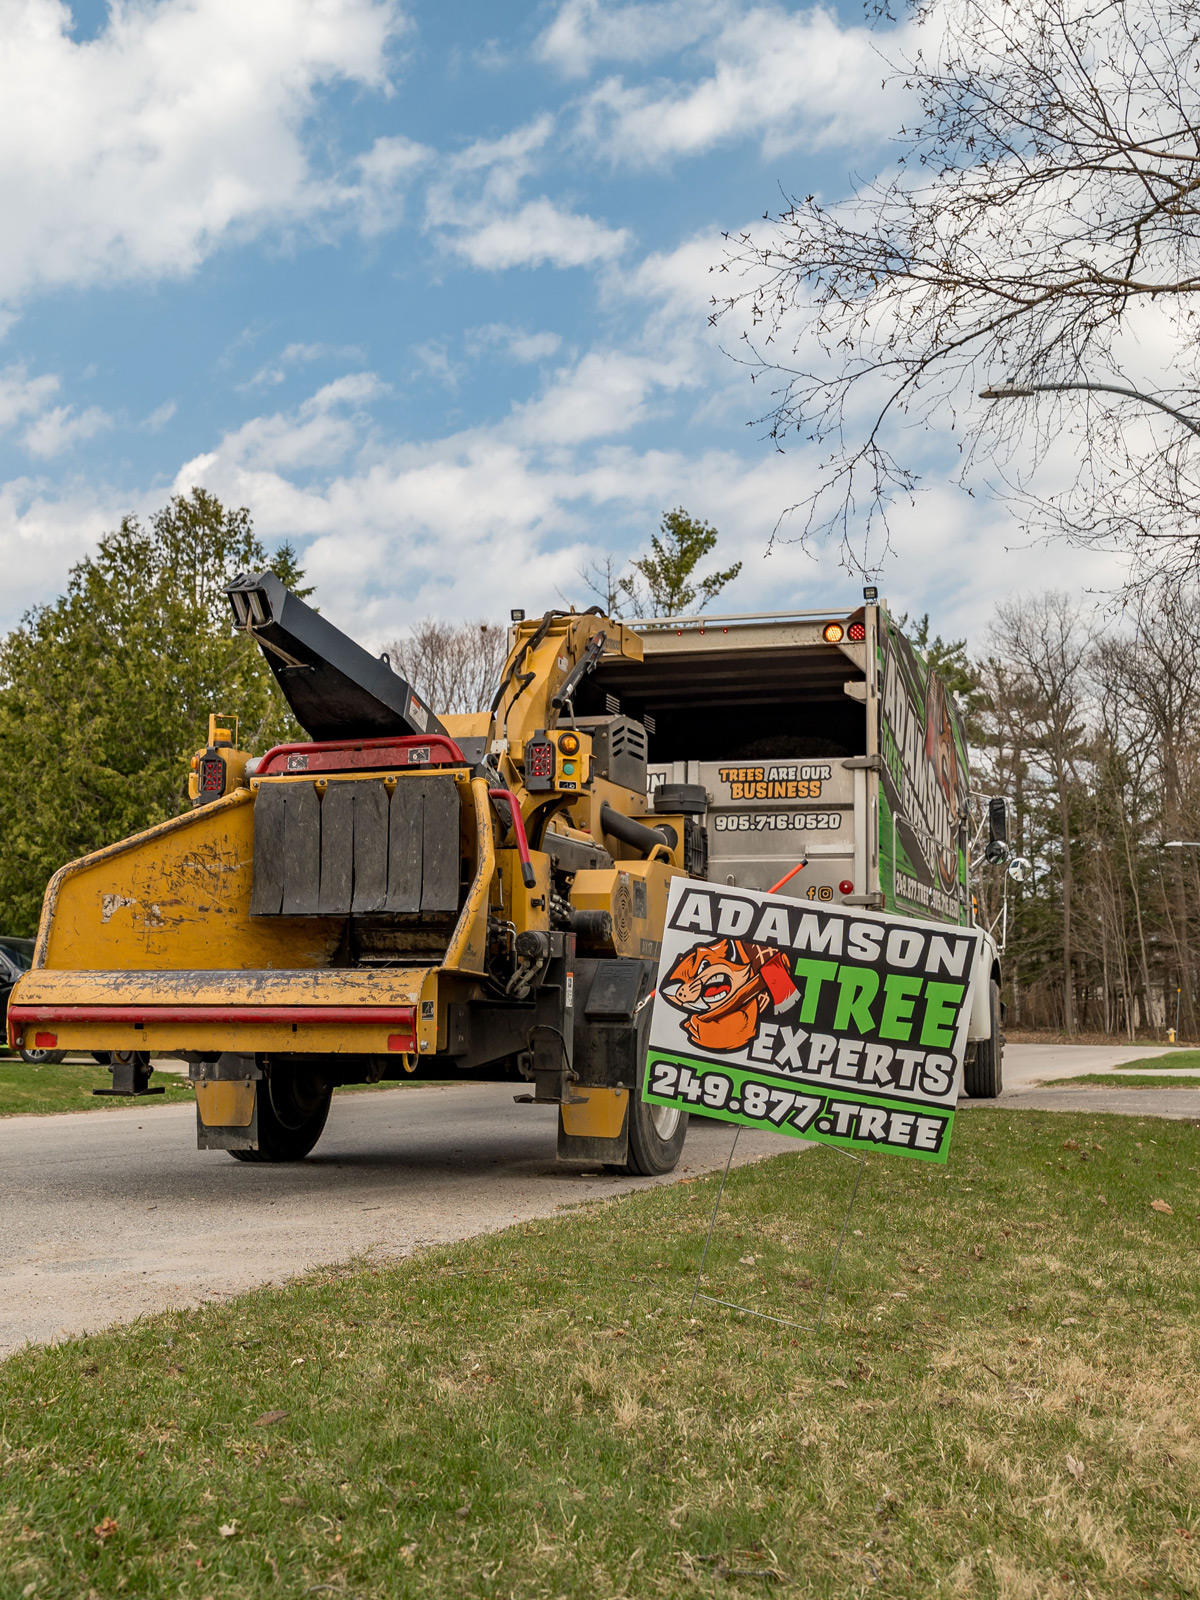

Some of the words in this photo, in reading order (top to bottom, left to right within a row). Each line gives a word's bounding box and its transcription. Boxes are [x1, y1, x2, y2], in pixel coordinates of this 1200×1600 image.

[719, 767, 764, 782] TREES
[768, 767, 797, 781] ARE
[801, 765, 831, 780] OUR
[731, 781, 821, 799] BUSINESS
[882, 717, 902, 794] TREE
[883, 651, 952, 875] ADAMSON
[715, 813, 841, 831] 905.716.0520
[673, 890, 971, 978] ADAMSON
[794, 957, 966, 1049] TREE
[750, 1022, 956, 1095] EXPERTS
[650, 1064, 944, 1150] 249.877.TREE
